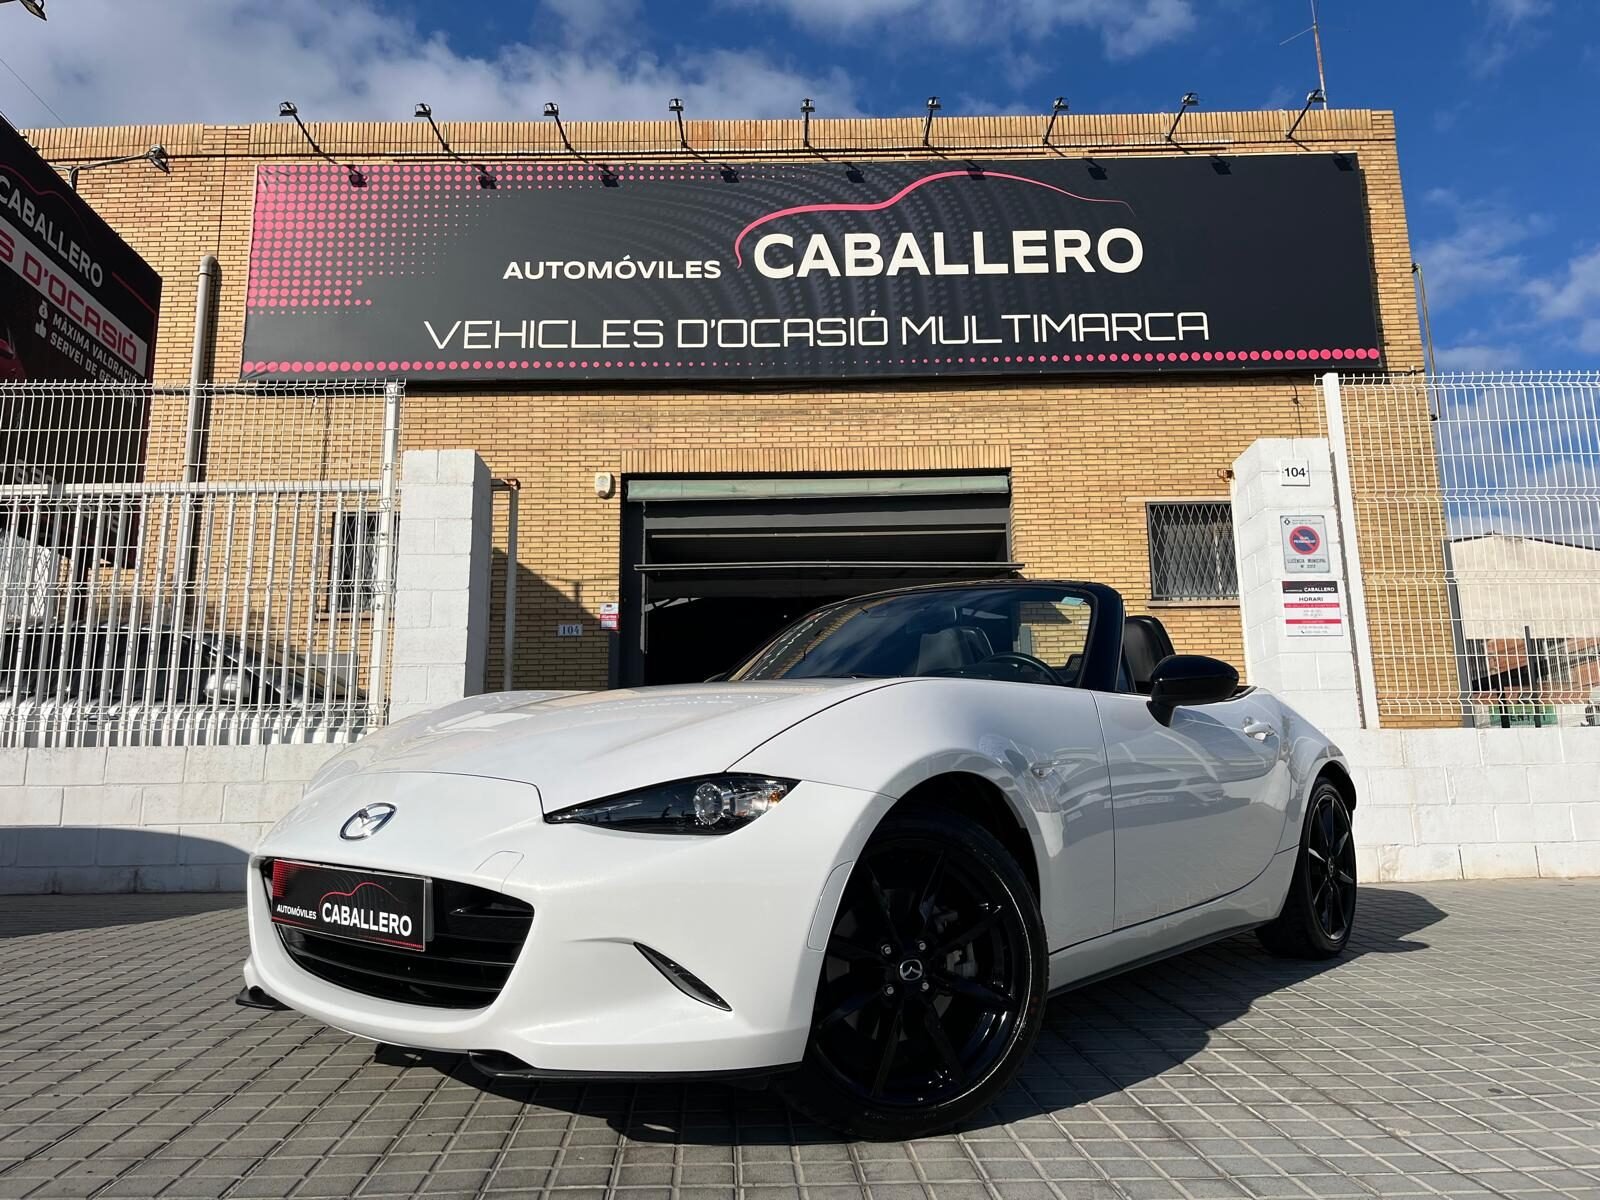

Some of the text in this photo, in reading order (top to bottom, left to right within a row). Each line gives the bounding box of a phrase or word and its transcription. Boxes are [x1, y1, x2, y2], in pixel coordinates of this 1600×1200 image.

[502, 227, 1144, 280] AUTOMÓVILES CABALLERO
[21, 251, 137, 366] D'OCASIÓ
[424, 309, 1209, 350] VEHICLES D'OCASIÓ MULTIMARCA
[50, 331, 84, 367] SERVEI
[84, 357, 98, 377] DE
[1284, 467, 1306, 478] 104
[562, 625, 580, 635] 104
[276, 902, 413, 937] AUTOMÓVILES CABALLERO
